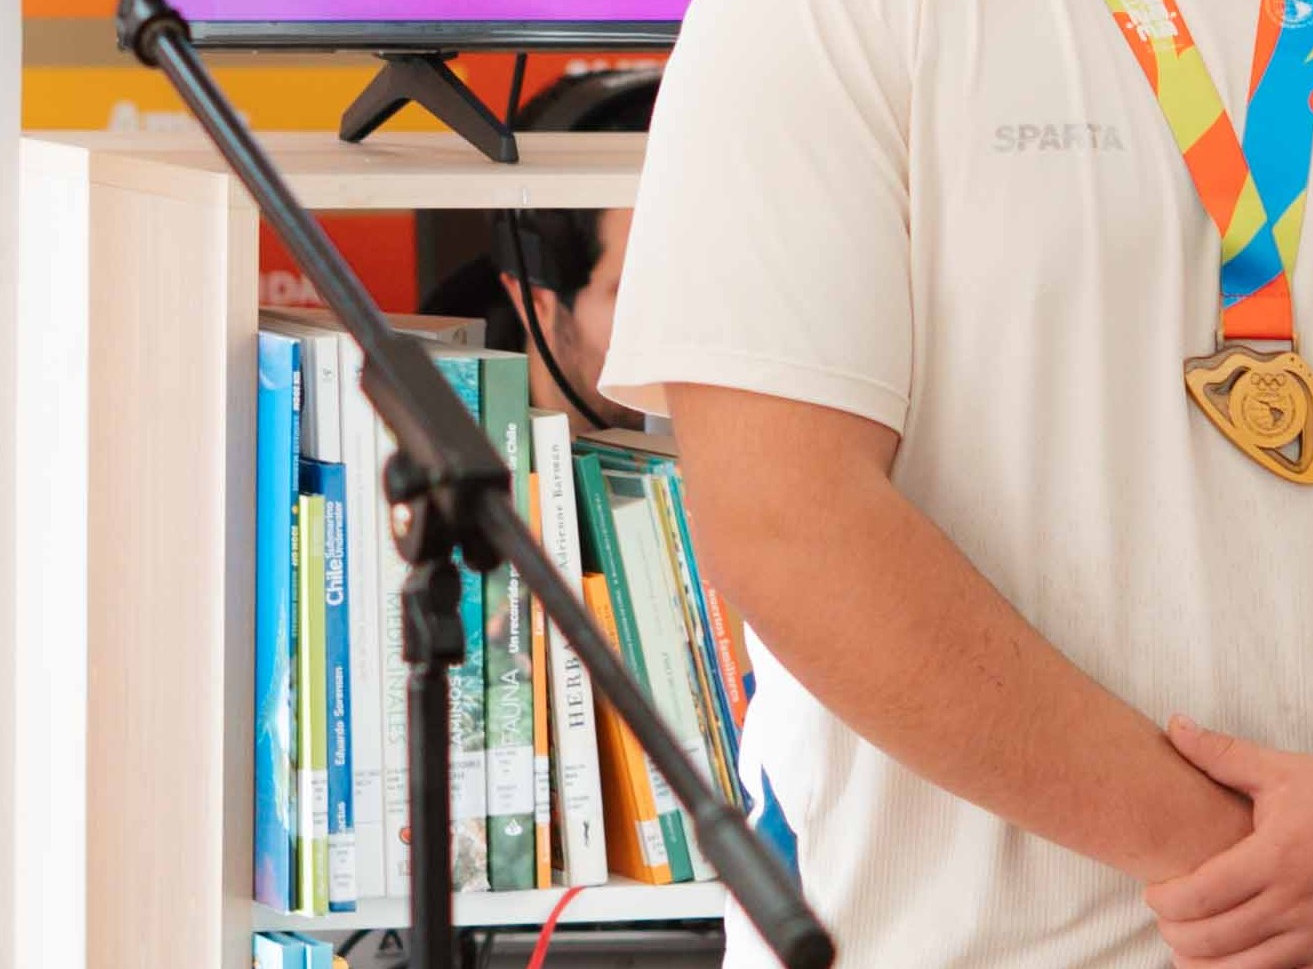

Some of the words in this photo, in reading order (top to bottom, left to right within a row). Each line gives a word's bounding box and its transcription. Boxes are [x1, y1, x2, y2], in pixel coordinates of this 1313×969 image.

[993, 122, 1125, 153] SPARTA
[506, 422, 518, 455] Chile
[326, 559, 344, 606] Chile
[508, 579, 520, 635] recorrido
[386, 591, 406, 745] MEDICINALES
[508, 636, 520, 654] Un
[719, 638, 740, 704] familiares
[448, 675, 462, 747] AMINOS
[500, 667, 520, 746] FAUNA
[335, 721, 346, 766] Eduardo
